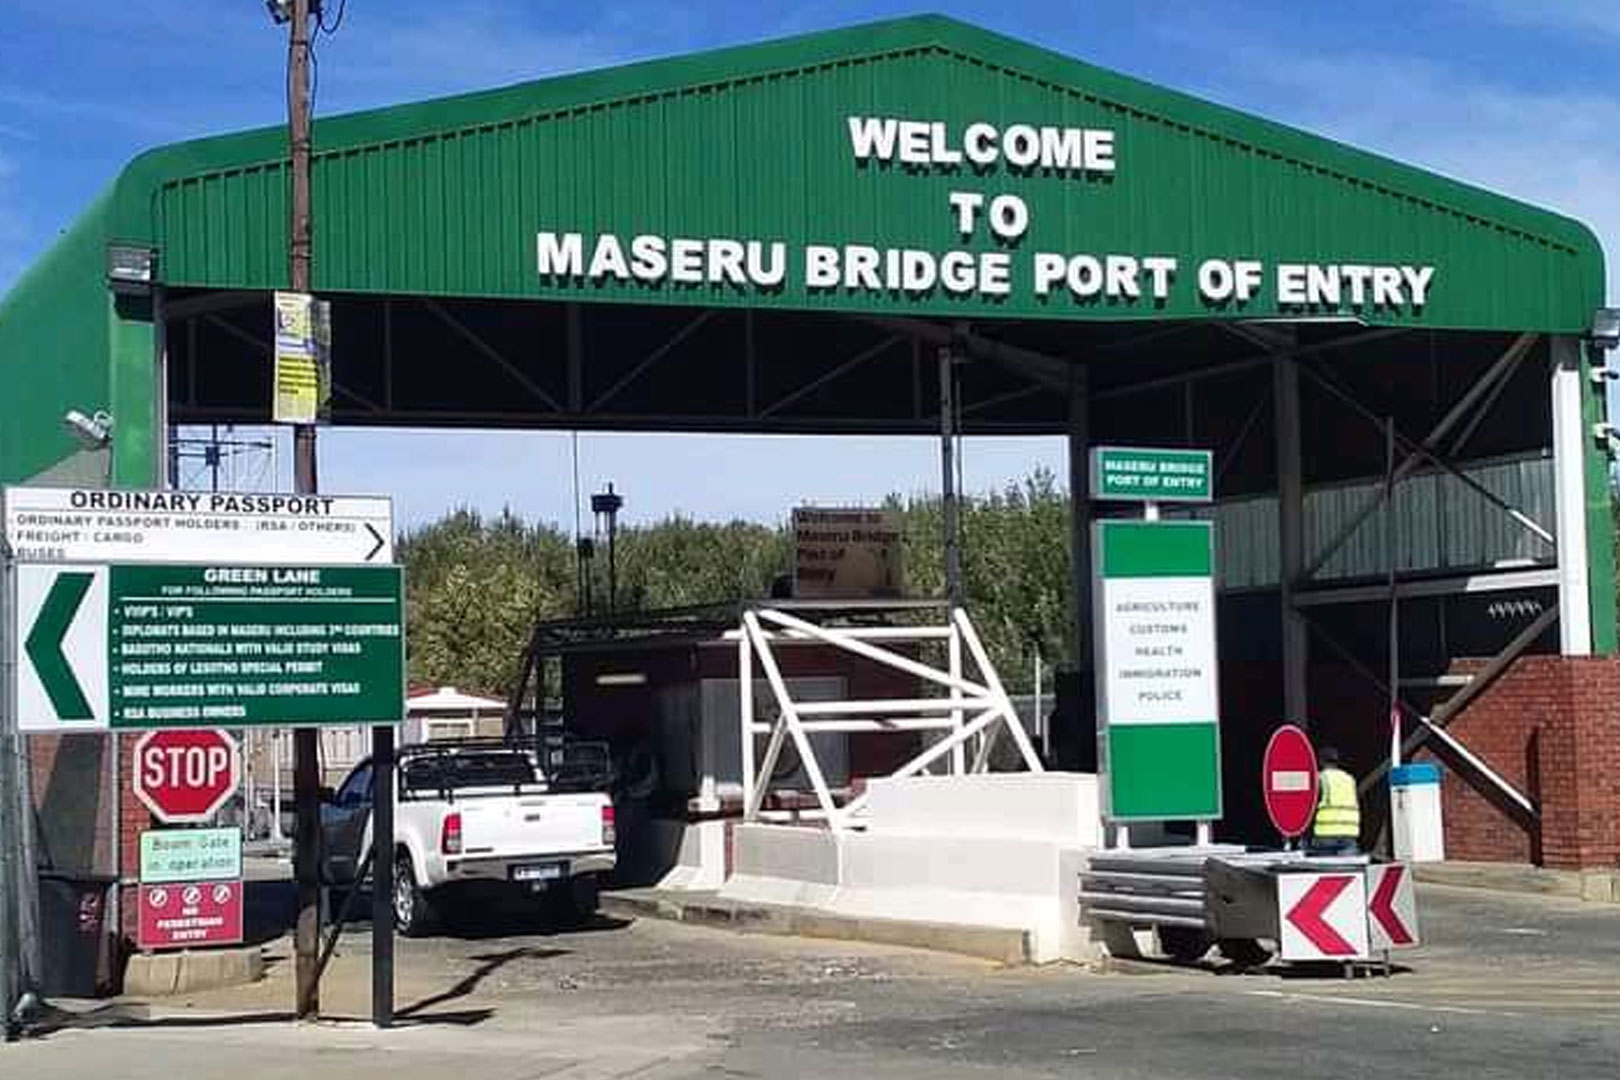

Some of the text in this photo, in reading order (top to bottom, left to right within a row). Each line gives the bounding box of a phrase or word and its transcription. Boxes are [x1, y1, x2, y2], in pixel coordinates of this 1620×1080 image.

[848, 116, 1116, 172] WELCOME
[949, 191, 1029, 237] TO
[537, 231, 1436, 306] MASERU BRIDGE PORT OF ENTRY
[1104, 460, 1205, 474] MASERU BRIDGE
[1106, 475, 1204, 489] PORT OF ENTRY
[71, 491, 334, 515] ORDINARY PASSPORT
[17, 514, 92, 527] ORDINARY
[97, 516, 171, 529] PASSPORT
[174, 519, 240, 531] HOLDERS
[17, 530, 81, 543] FREIGHT
[93, 532, 144, 544] CARGO
[17, 547, 66, 560] BUSES
[204, 569, 320, 584] GREEN LANE
[161, 585, 352, 597] FOR FOLLOWING PASSPORT HOLDERS
[1116, 602, 1199, 612] AGRICULTURE
[122, 624, 179, 637] DIPLOMATS
[182, 624, 216, 637] BASED
[217, 625, 229, 637] IN
[344, 624, 399, 636] COUNTRIES
[1129, 623, 1188, 635] CUSTOMS
[174, 643, 232, 655] NATIONALS
[235, 643, 262, 655] WITH
[264, 643, 295, 655] VALID
[296, 643, 329, 655] STUDY
[331, 643, 361, 655] VISAS
[1135, 645, 1184, 656] HEALTH
[122, 660, 322, 675] HOLDERS OF LESOTHO SPECIAL PERMIT
[1119, 668, 1202, 680] IMMIGRATION
[206, 684, 235, 697] WITH
[236, 683, 266, 696] VALID
[268, 683, 329, 696] CORPORATE
[331, 682, 361, 695] VISAS
[1138, 690, 1184, 702] POLICE
[144, 746, 228, 788] STOP
[168, 857, 235, 872] operation
[156, 916, 224, 929] PEDESTRIAN
[172, 929, 208, 940] ENTRY
